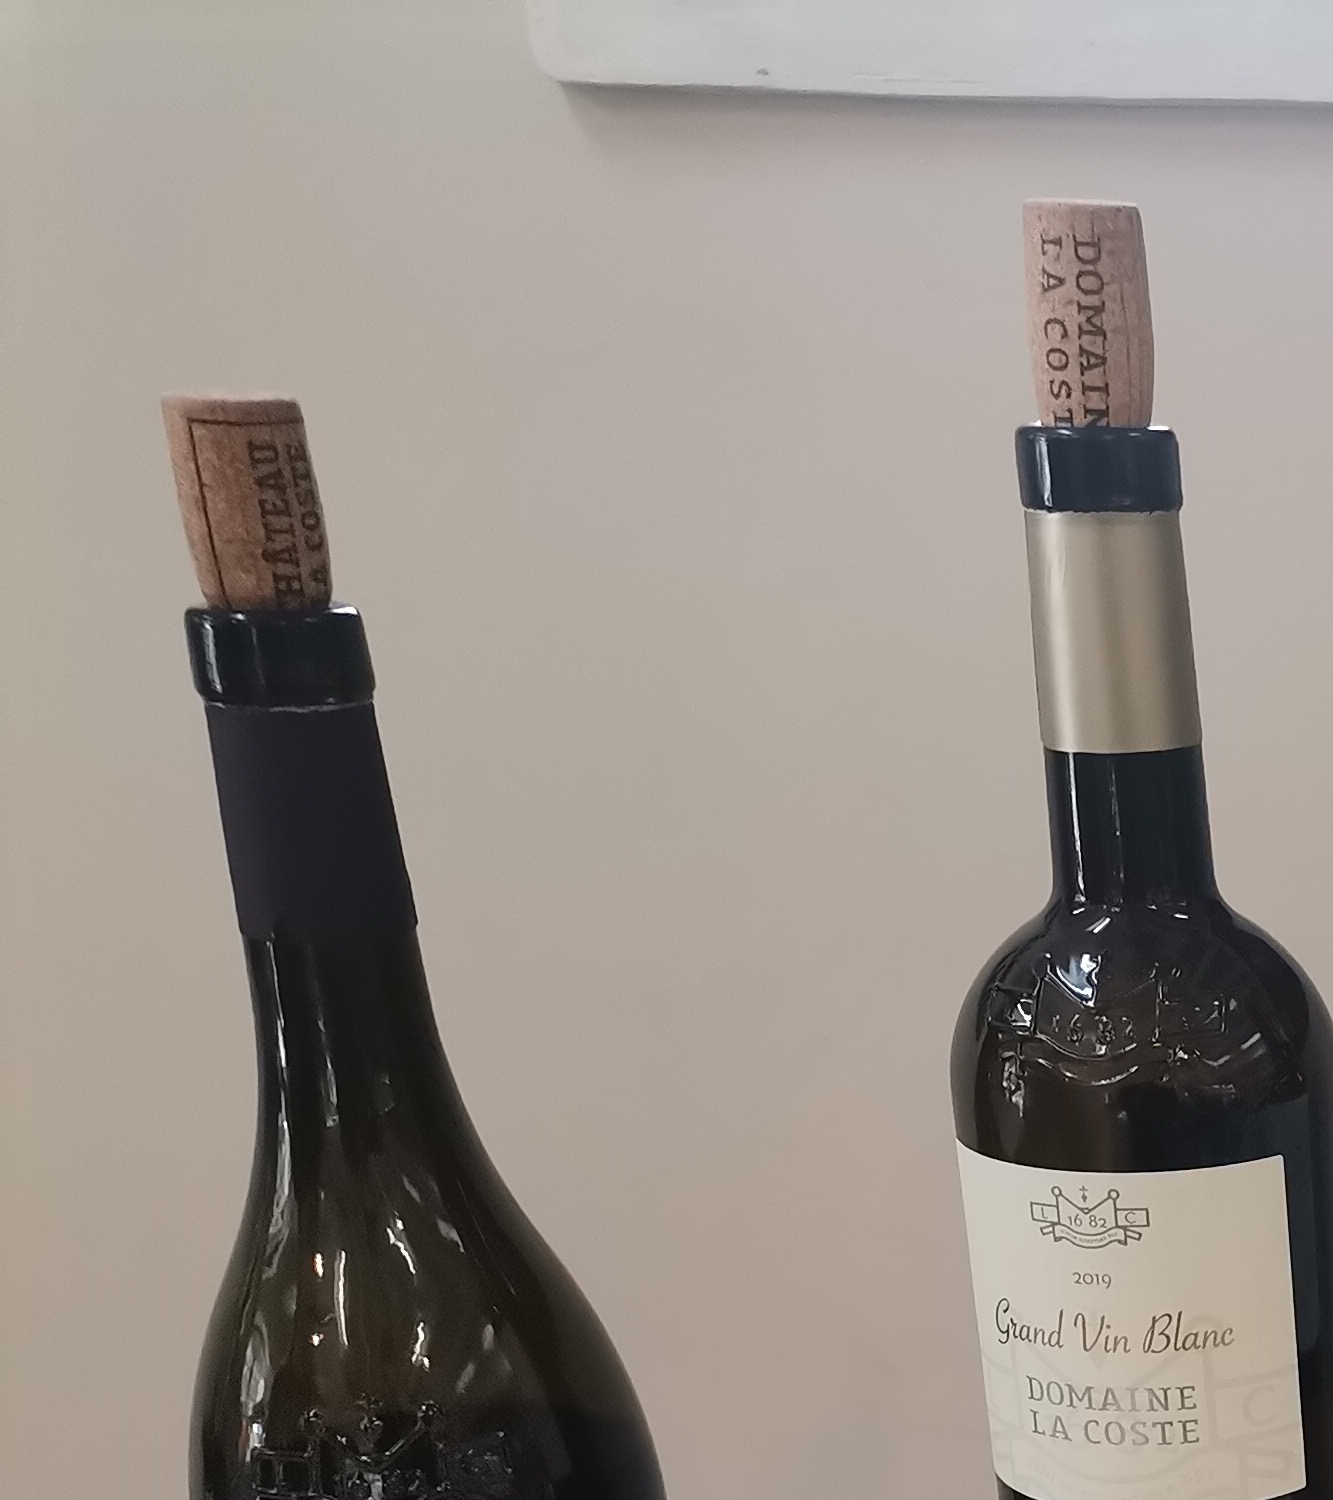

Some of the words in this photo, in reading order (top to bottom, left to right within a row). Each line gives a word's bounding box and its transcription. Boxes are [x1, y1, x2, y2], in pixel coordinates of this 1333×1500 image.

[1040, 233, 1066, 293] LA
[1072, 233, 1109, 427] DOMAIN
[1044, 317, 1074, 427] COST
[247, 440, 305, 608] HÂTEAU
[1072, 1271, 1113, 1290] 2019
[995, 1297, 1065, 1350] Grand
[1073, 1311, 1132, 1354] Vin
[1142, 1309, 1235, 1354] Blanc
[1026, 1374, 1198, 1413] DOMAINE
[1029, 1408, 1073, 1443] LA
[1083, 1418, 1201, 1447] COSTE
